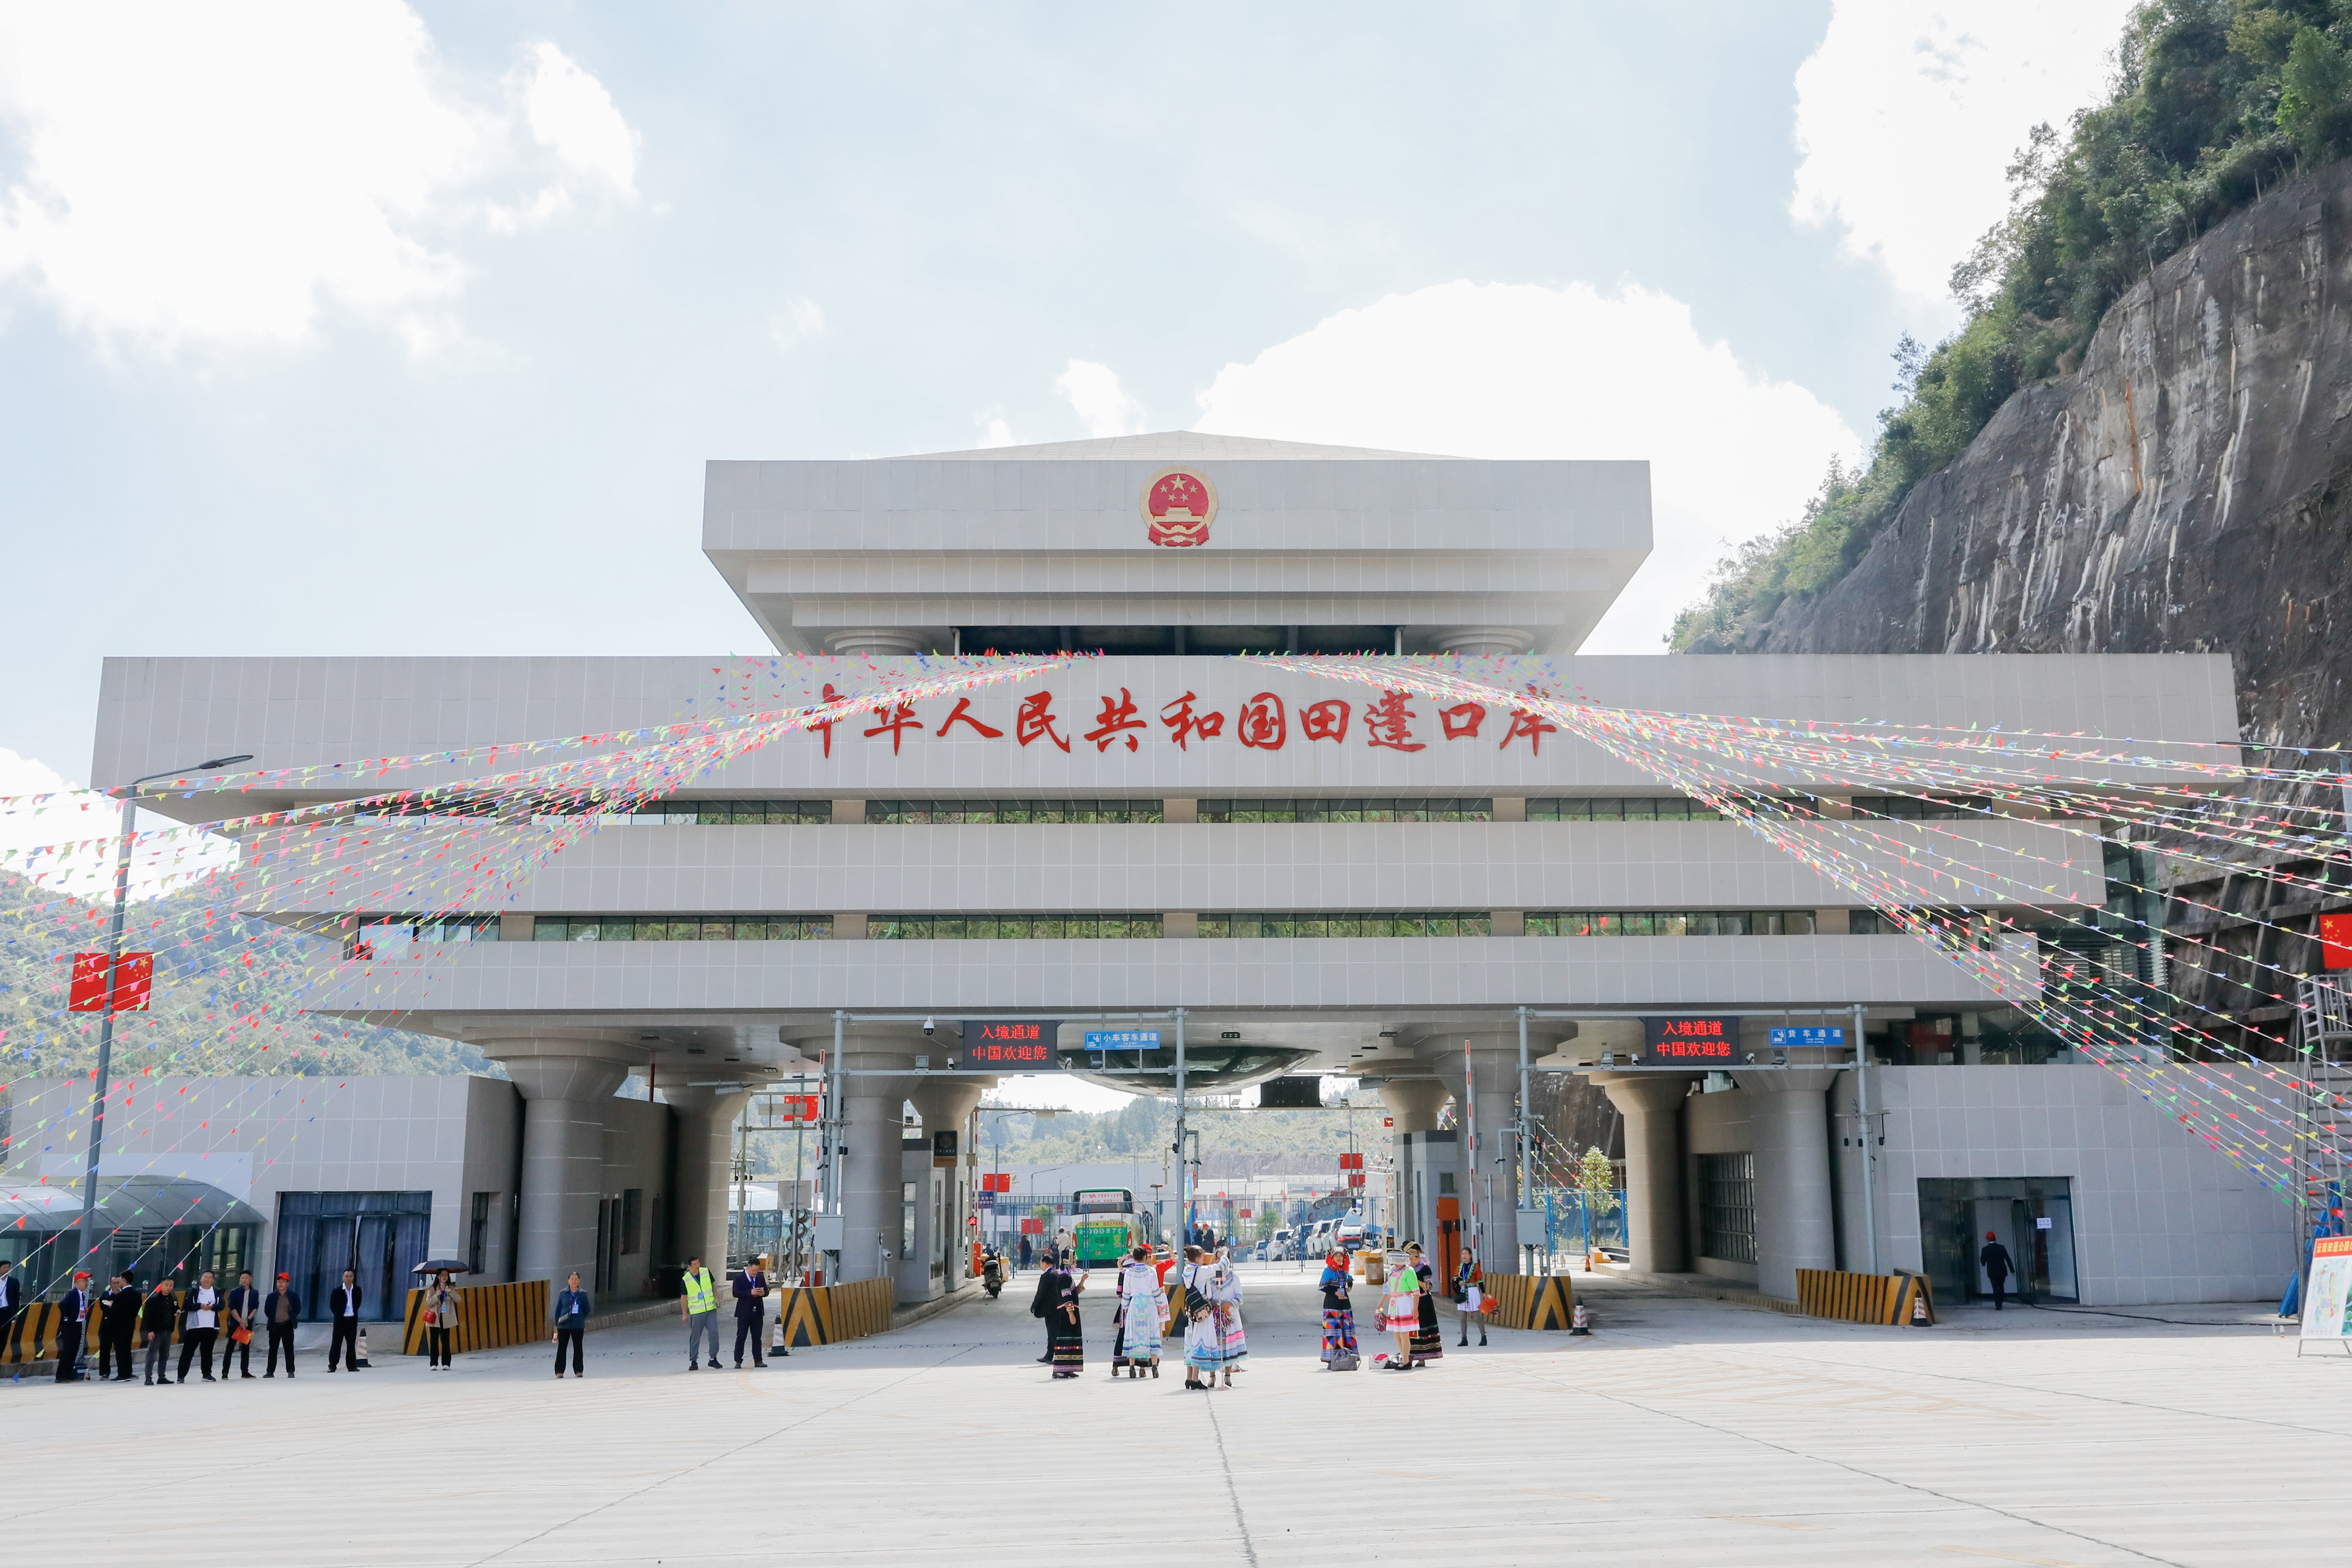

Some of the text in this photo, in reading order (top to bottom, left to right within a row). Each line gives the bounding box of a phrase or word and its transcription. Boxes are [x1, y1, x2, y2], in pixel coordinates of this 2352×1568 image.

[803, 682, 1557, 759] 中华人民共和国田蓬口岸
[980, 1025, 1040, 1040] 入境通道
[1663, 1021, 1723, 1036] 入境通道
[1788, 1029, 1841, 1038] 货车通道
[1103, 1033, 1157, 1042] 小车客车通道
[973, 1045, 1047, 1060] 中国欢迎您
[1657, 1042, 1731, 1057] 中国欢迎您
